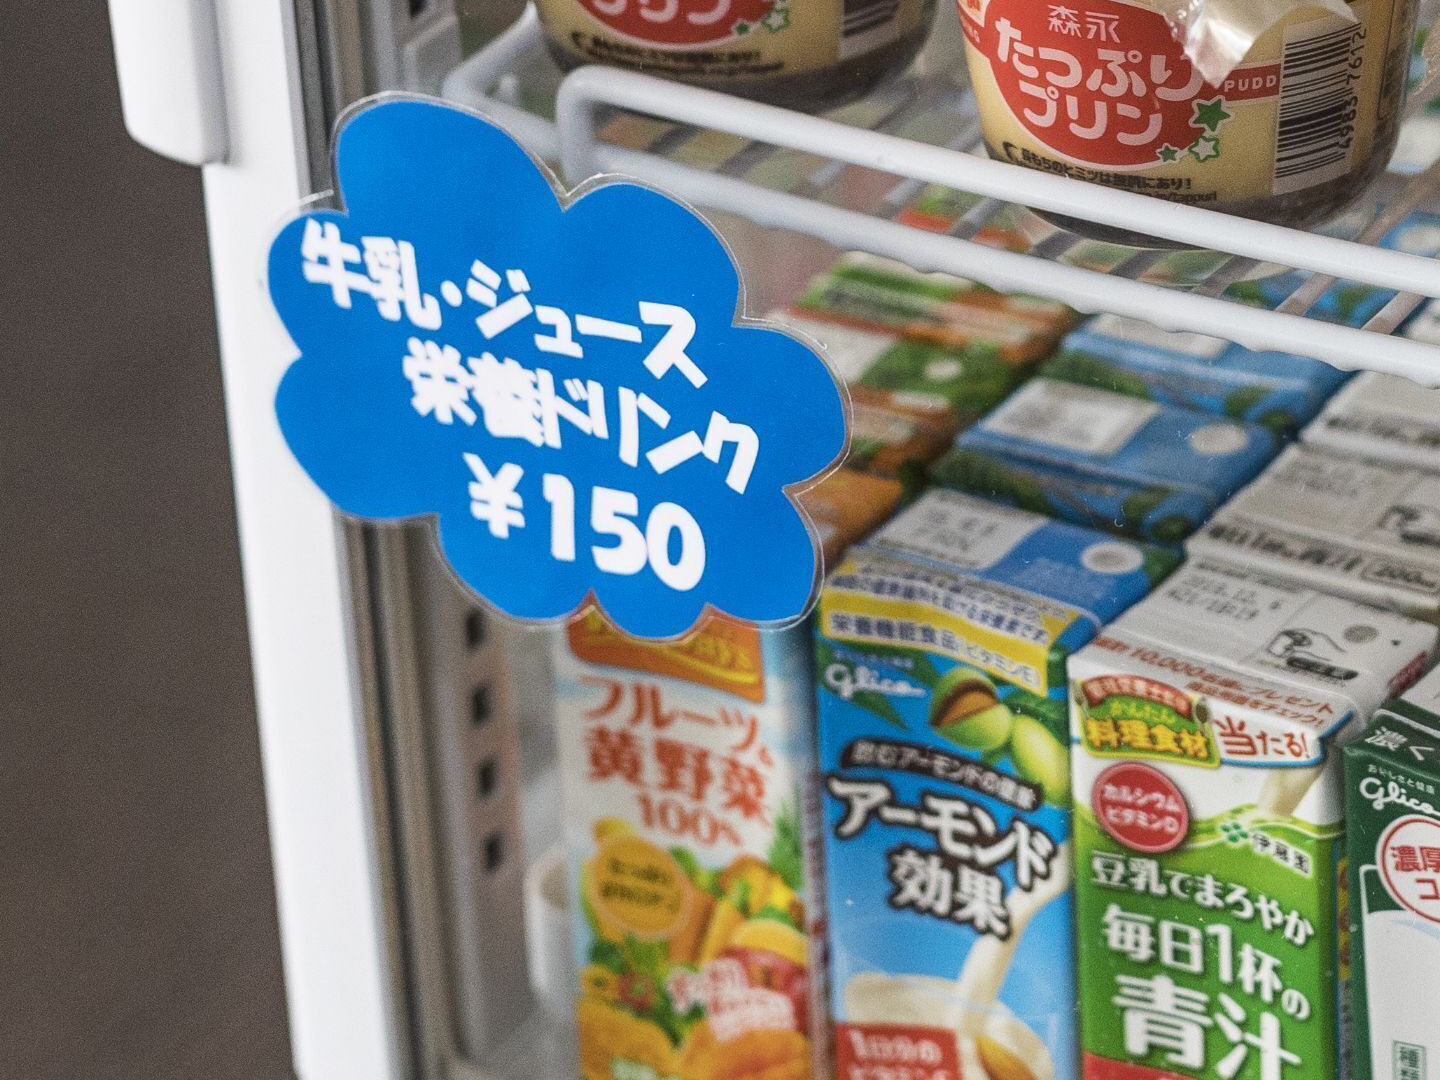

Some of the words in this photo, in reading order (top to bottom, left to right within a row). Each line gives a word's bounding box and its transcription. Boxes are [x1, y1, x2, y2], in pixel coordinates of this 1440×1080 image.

[995, 17, 1205, 101] たっぷり
[1047, 4, 1121, 43] 森永
[1018, 80, 1163, 147] プリン
[300, 218, 708, 389] 牛乳・ジュース
[402, 337, 761, 494] 栄養ドリンク
[462, 452, 706, 591] ¥150
[827, 775, 1054, 890] アーモンド
[889, 850, 1012, 942] 効果
[1091, 851, 1315, 947] 豆乳でまろやか
[1104, 904, 1311, 1019] 毎日1杯の
[1112, 975, 1301, 1080] 青汁
